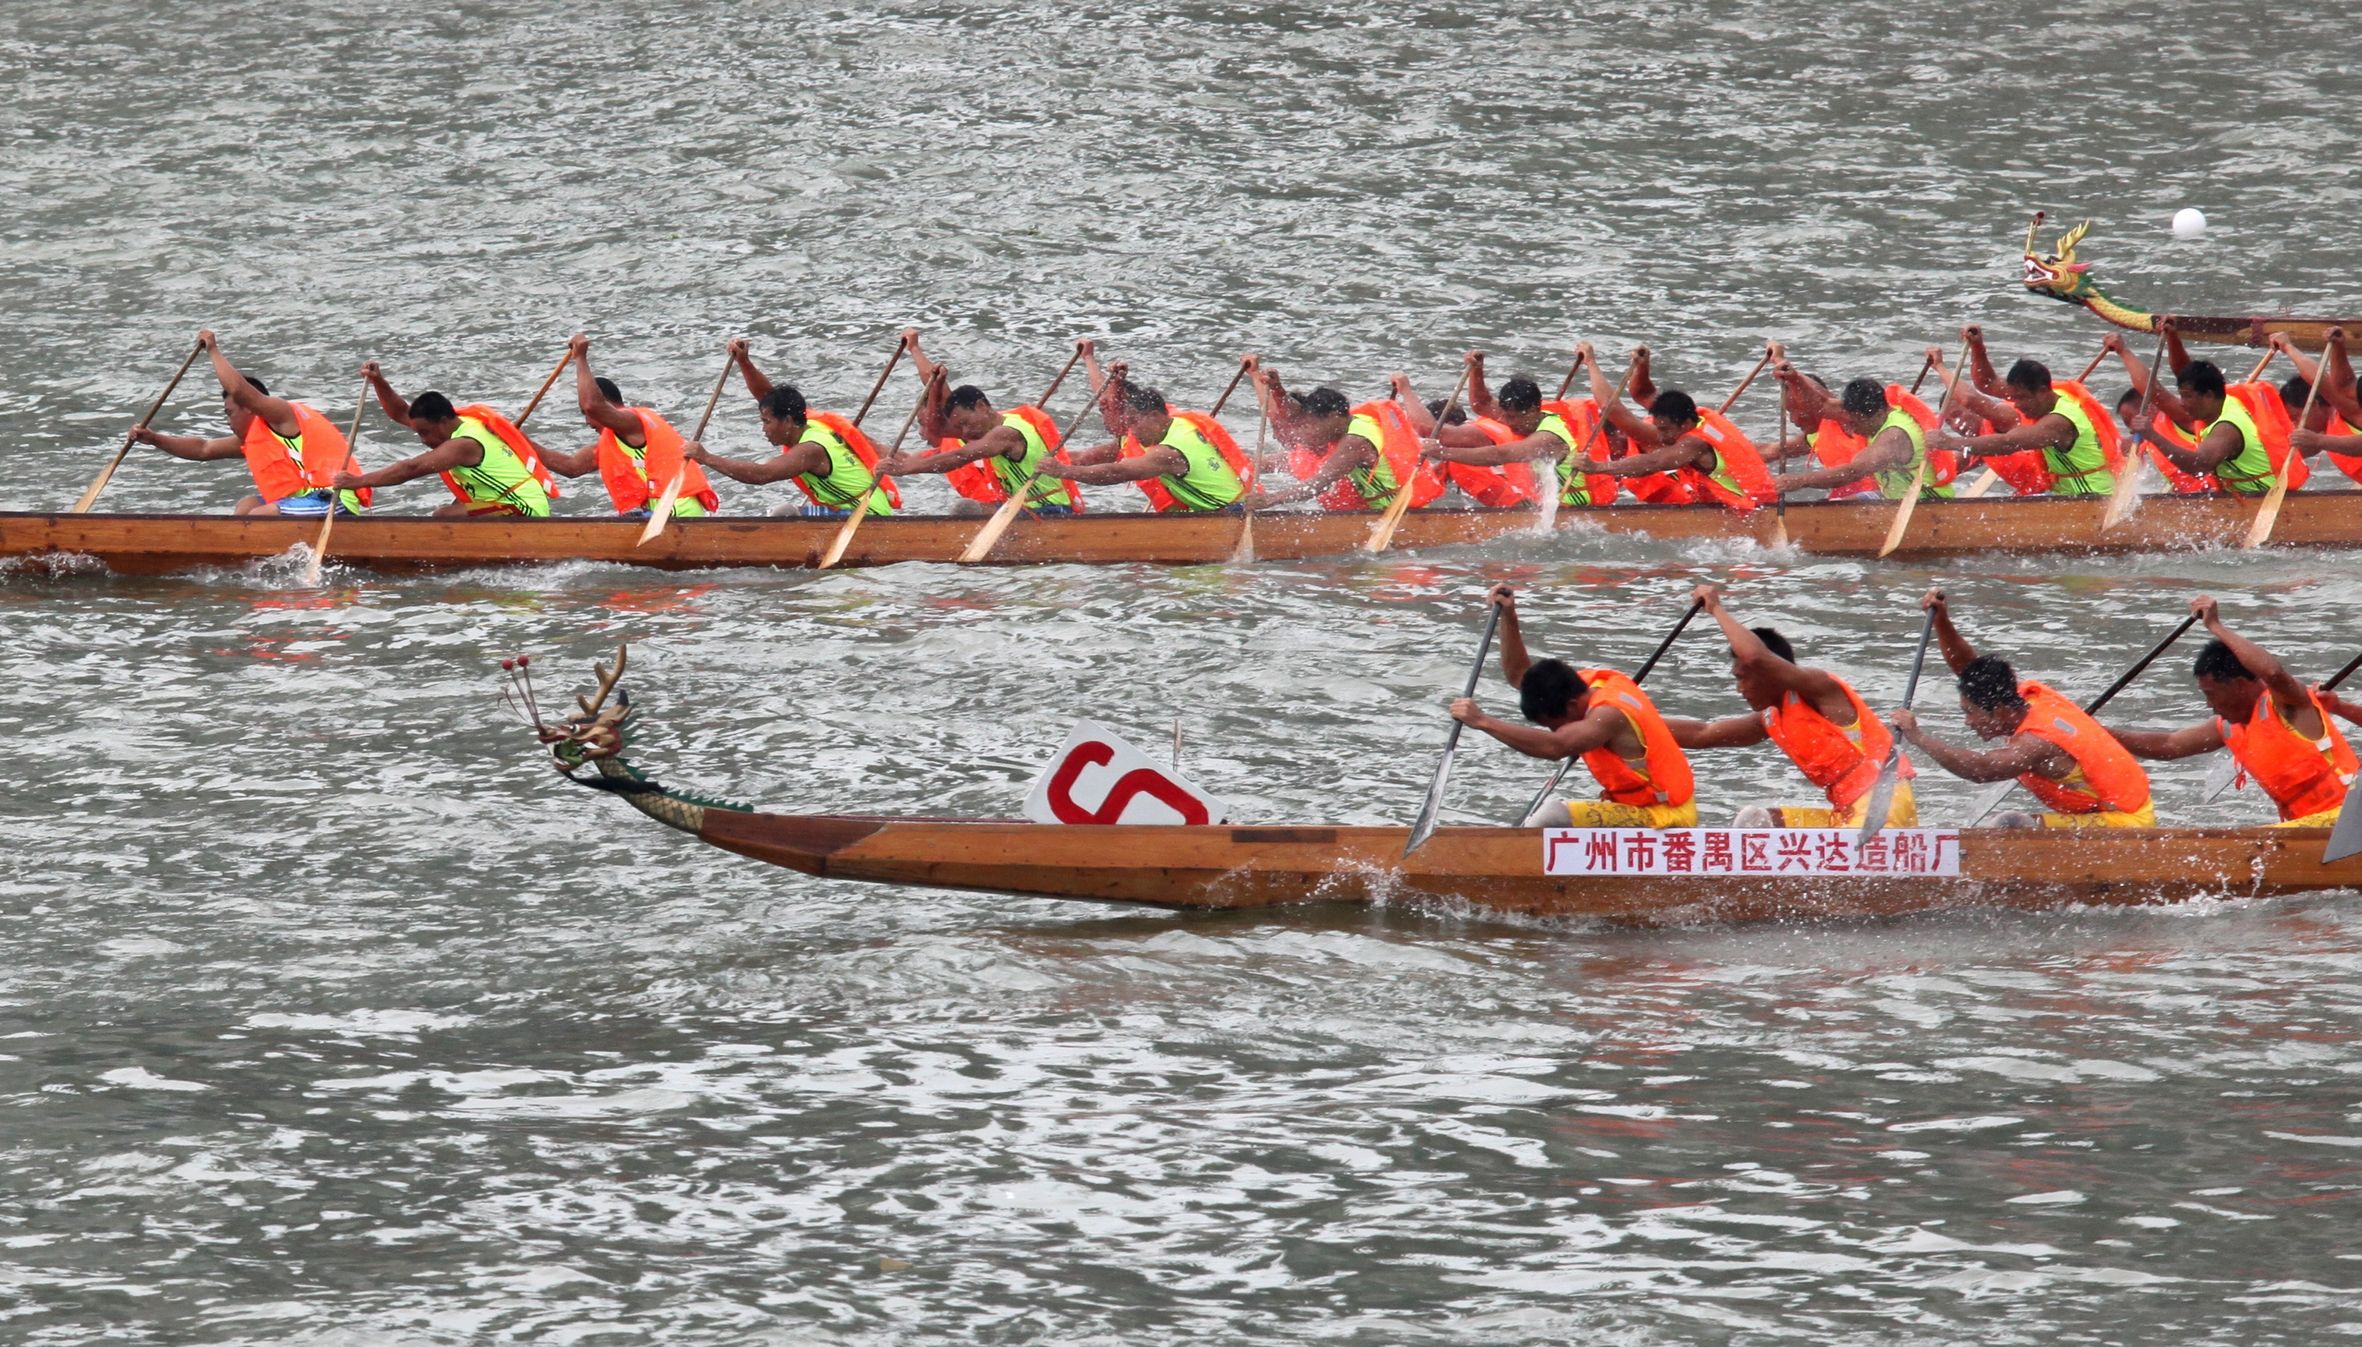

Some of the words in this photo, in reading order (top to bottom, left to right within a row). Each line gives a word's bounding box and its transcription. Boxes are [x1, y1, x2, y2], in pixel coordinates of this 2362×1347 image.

[1547, 831, 1959, 872] 广州市番禺区兴达造船厂
